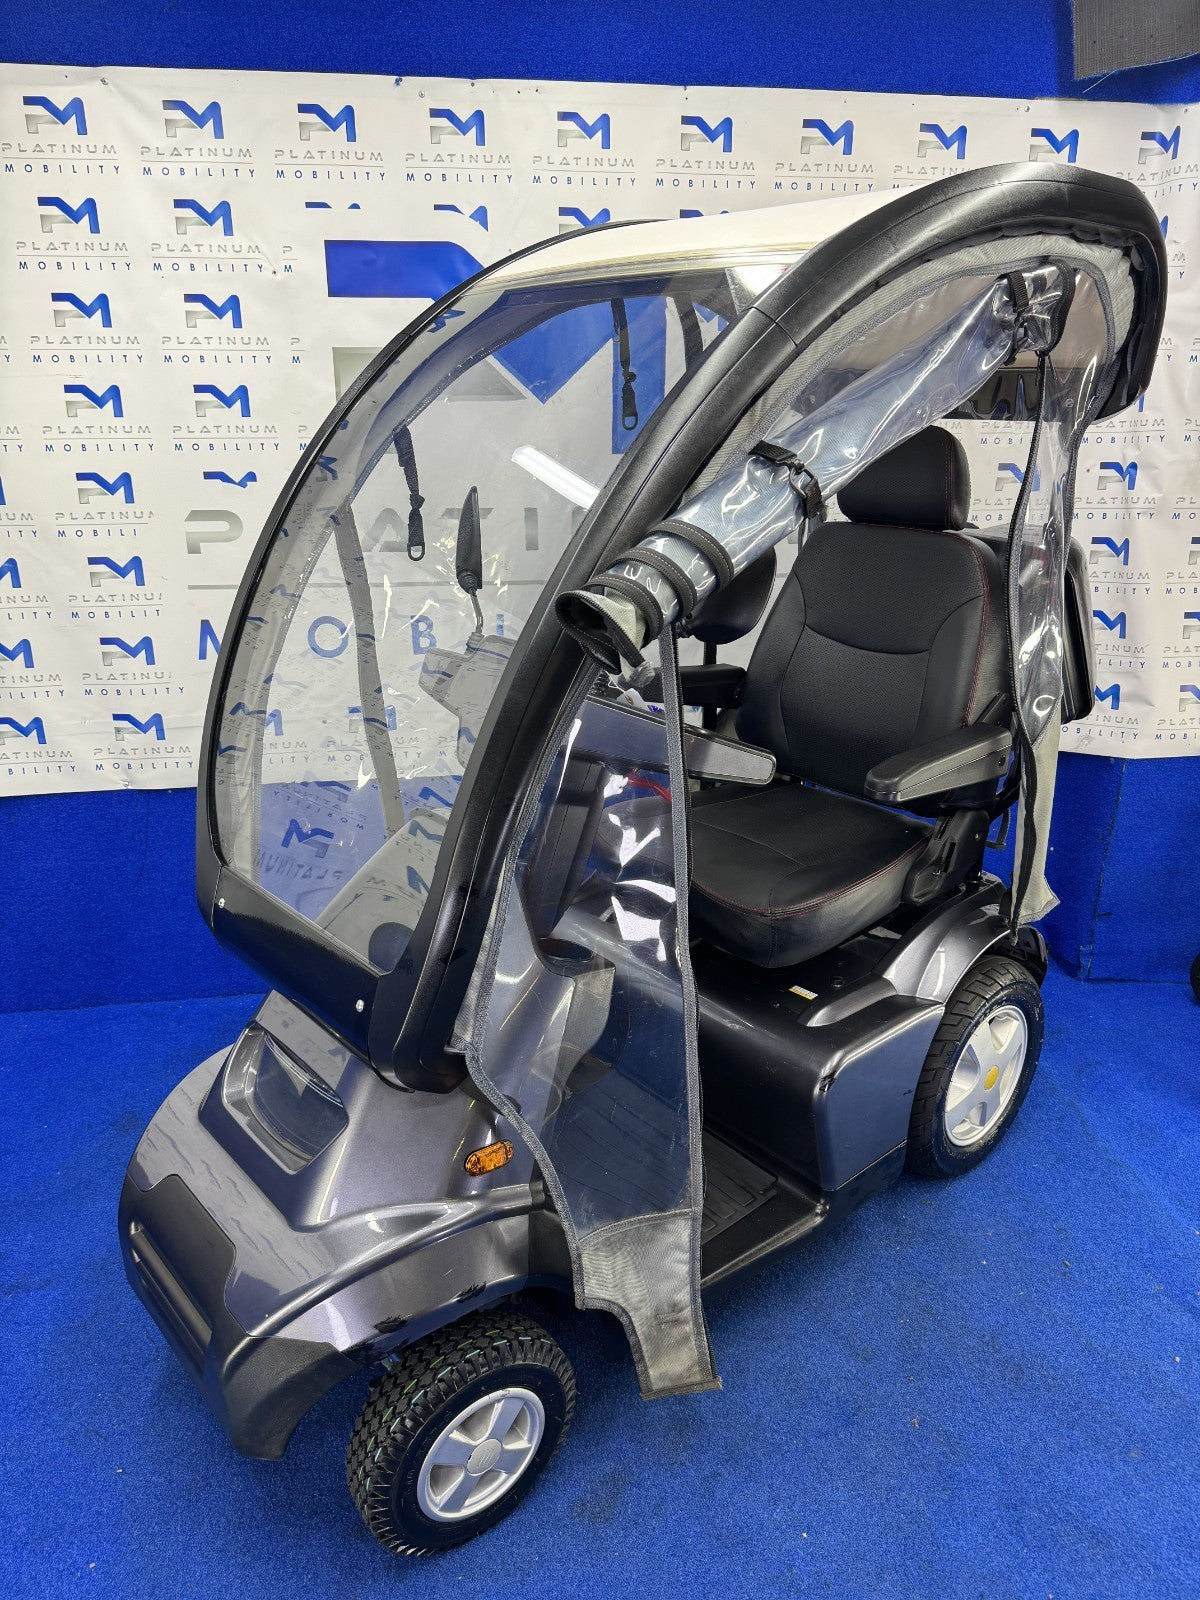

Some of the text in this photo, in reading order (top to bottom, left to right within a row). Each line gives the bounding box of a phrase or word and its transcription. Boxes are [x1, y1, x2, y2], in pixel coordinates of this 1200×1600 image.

[1, 142, 117, 154] PLATINUM
[140, 146, 252, 158] PLATINUM
[275, 150, 384, 161] PLATINUM
[405, 153, 511, 164] PLATINUM
[532, 155, 635, 167] PLATINUM
[5, 163, 120, 174] MOBILITY
[655, 159, 755, 170] PLATINUM
[775, 162, 874, 173] PLATINUM
[143, 167, 255, 177] MOBILITY
[276, 170, 385, 181] MOBILITY
[406, 173, 513, 183] MOBILITY
[532, 175, 636, 186] MOBILITY
[655, 178, 755, 189] MOBILITY
[774, 182, 874, 192] MOBILITY
[1142, 182, 1198, 198] ILITY
[16, 241, 128, 252] PLATINUM
[150, 242, 261, 254] PLATINUM
[19, 261, 131, 271] MOBILITY
[153, 262, 264, 273] MOBILITY
[30, 336, 141, 345] PLATINUM
[162, 336, 270, 346] PLATINUM
[33, 354, 143, 363] MOBILITY
[164, 355, 272, 364] MOBILITY
[43, 425, 151, 434] PLATINUM
[173, 424, 277, 434] PLATINUM
[45, 443, 154, 452] MOBILITY
[174, 443, 280, 452] MOBILITY
[84, 687, 185, 696] MOBILITY
[93, 745, 192, 756] PLATINUM
[95, 760, 194, 771] MOBILITY
